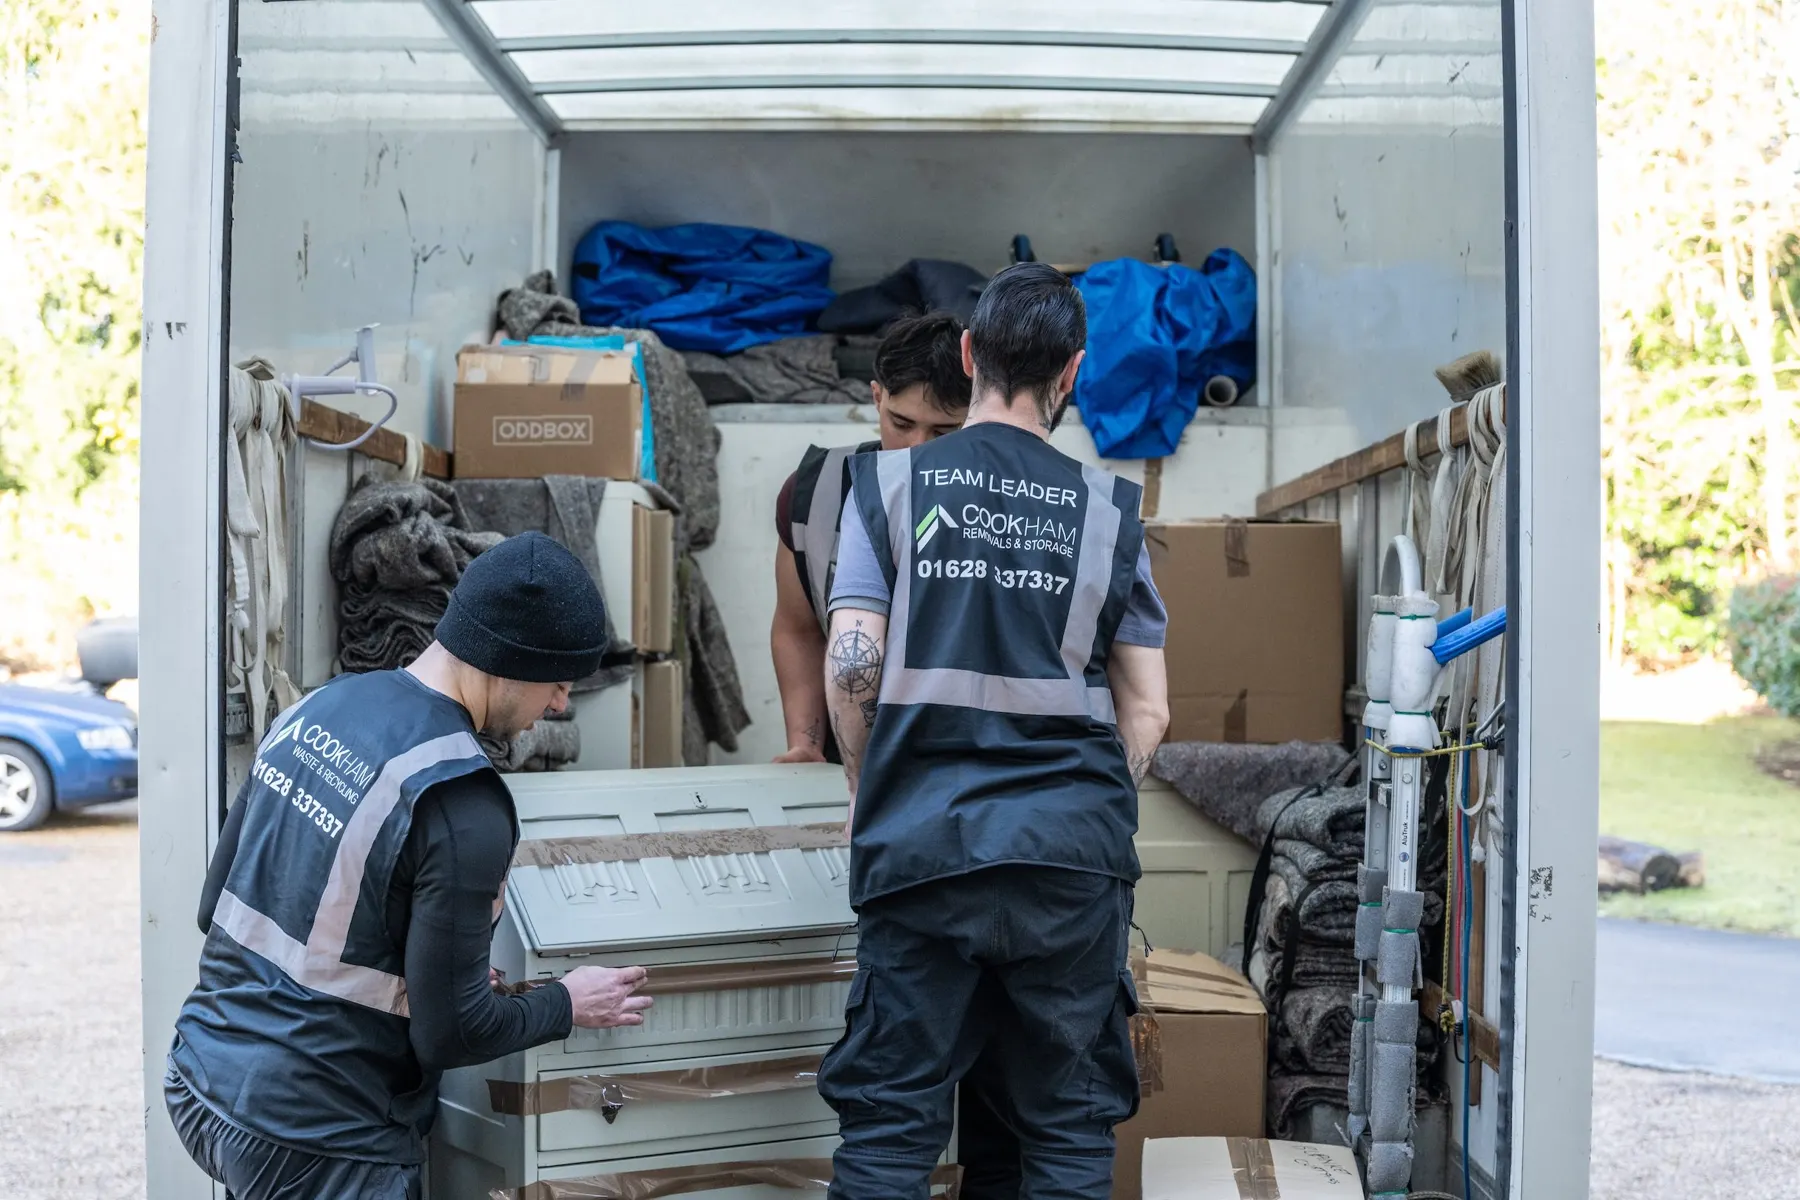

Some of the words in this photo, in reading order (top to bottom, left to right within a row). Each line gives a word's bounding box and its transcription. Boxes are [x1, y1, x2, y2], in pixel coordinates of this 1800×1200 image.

[499, 421, 587, 439] ODDBOX
[919, 468, 983, 488] TEAM
[988, 474, 1078, 508] LEADER
[962, 503, 1077, 546] COOKHAM
[962, 528, 1012, 549] REMOVALS
[1013, 538, 1021, 549] &
[1024, 539, 1074, 559] STORAGE
[917, 559, 987, 578] 01628
[994, 566, 1070, 595] 337337
[292, 745, 320, 770] WASTE
[316, 764, 325, 775] &
[321, 768, 360, 805] RECYCLING
[303, 724, 376, 790] COOKHAM
[253, 758, 294, 797] 01628
[291, 787, 344, 839] 337337
[1401, 821, 1409, 846] AluTruk
